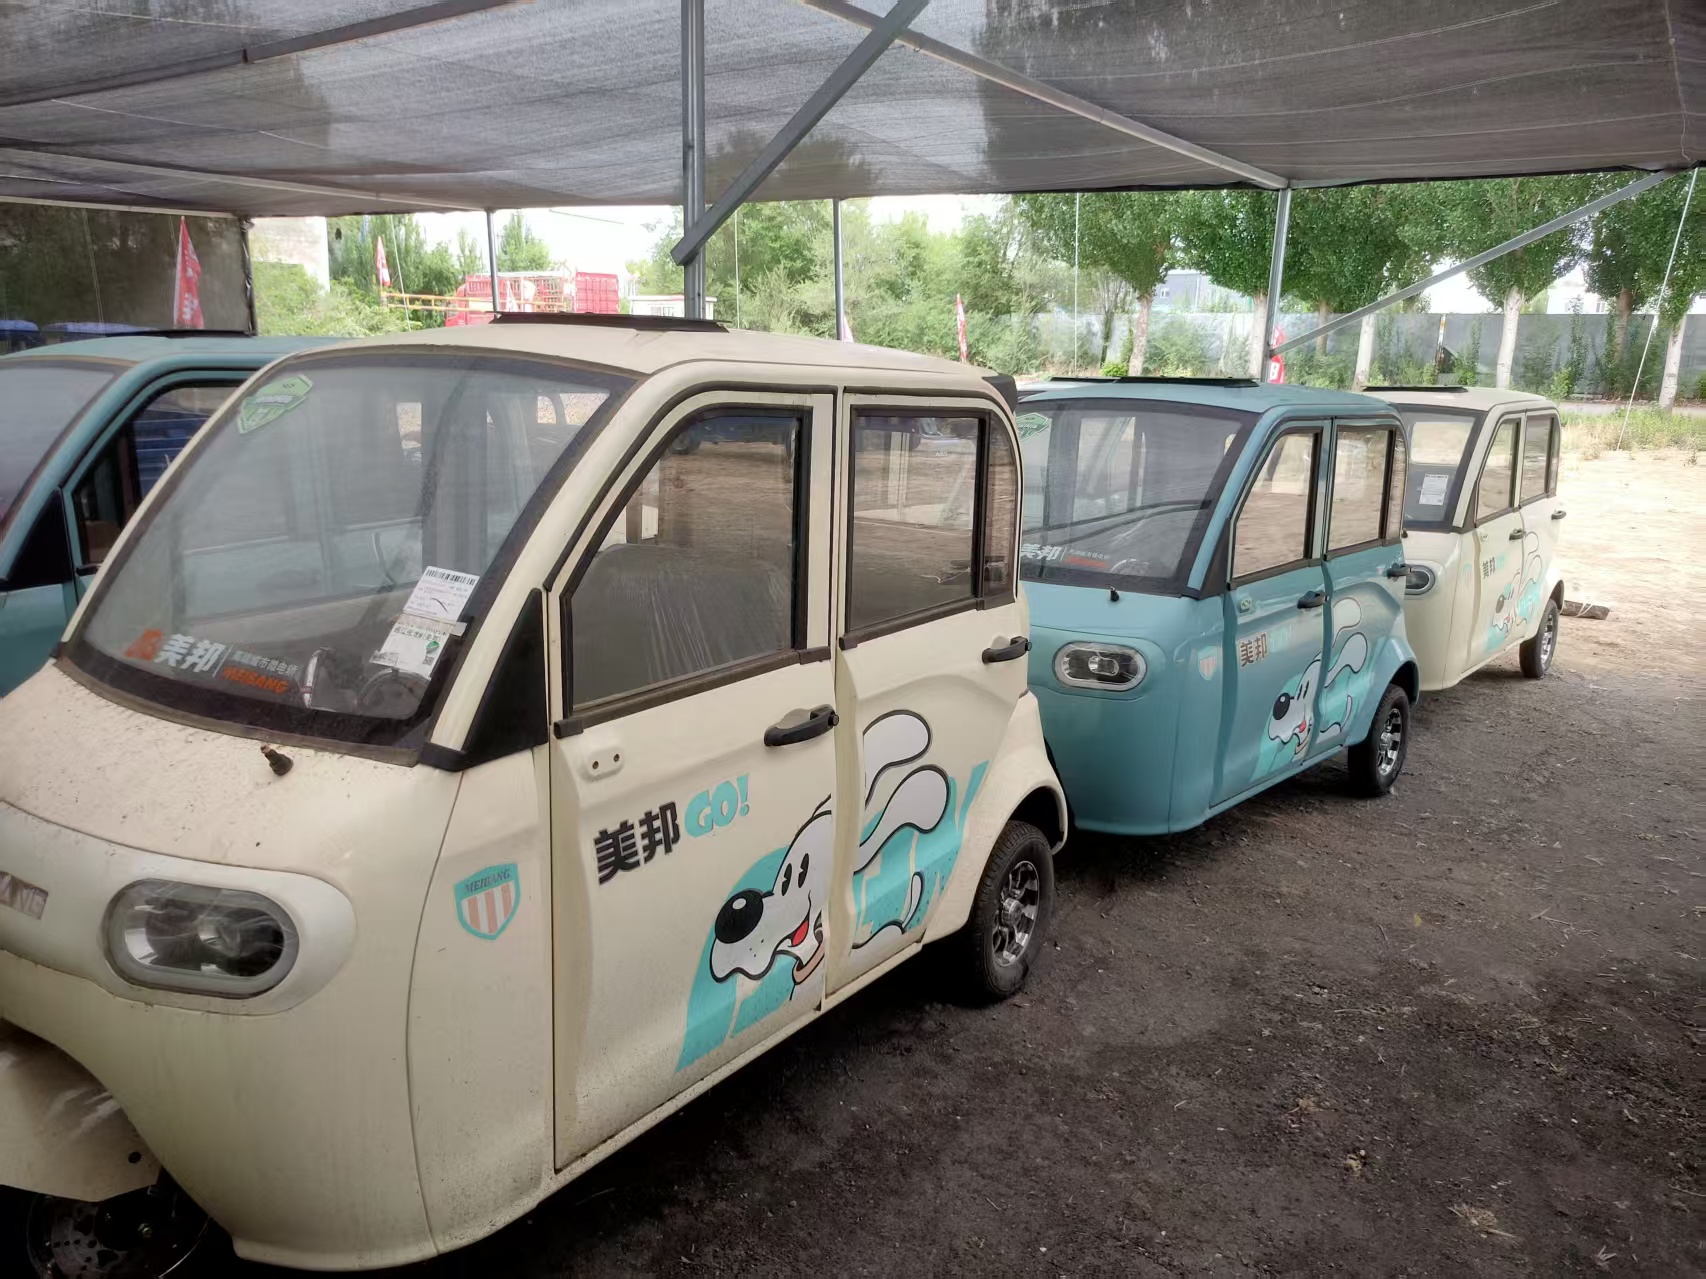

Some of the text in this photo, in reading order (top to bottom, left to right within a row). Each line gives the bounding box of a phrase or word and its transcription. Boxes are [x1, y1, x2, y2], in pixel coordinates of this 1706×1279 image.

[154, 633, 226, 672] 美邦
[1240, 633, 1267, 668] 美邦
[593, 772, 750, 885] 美邦 GO!
